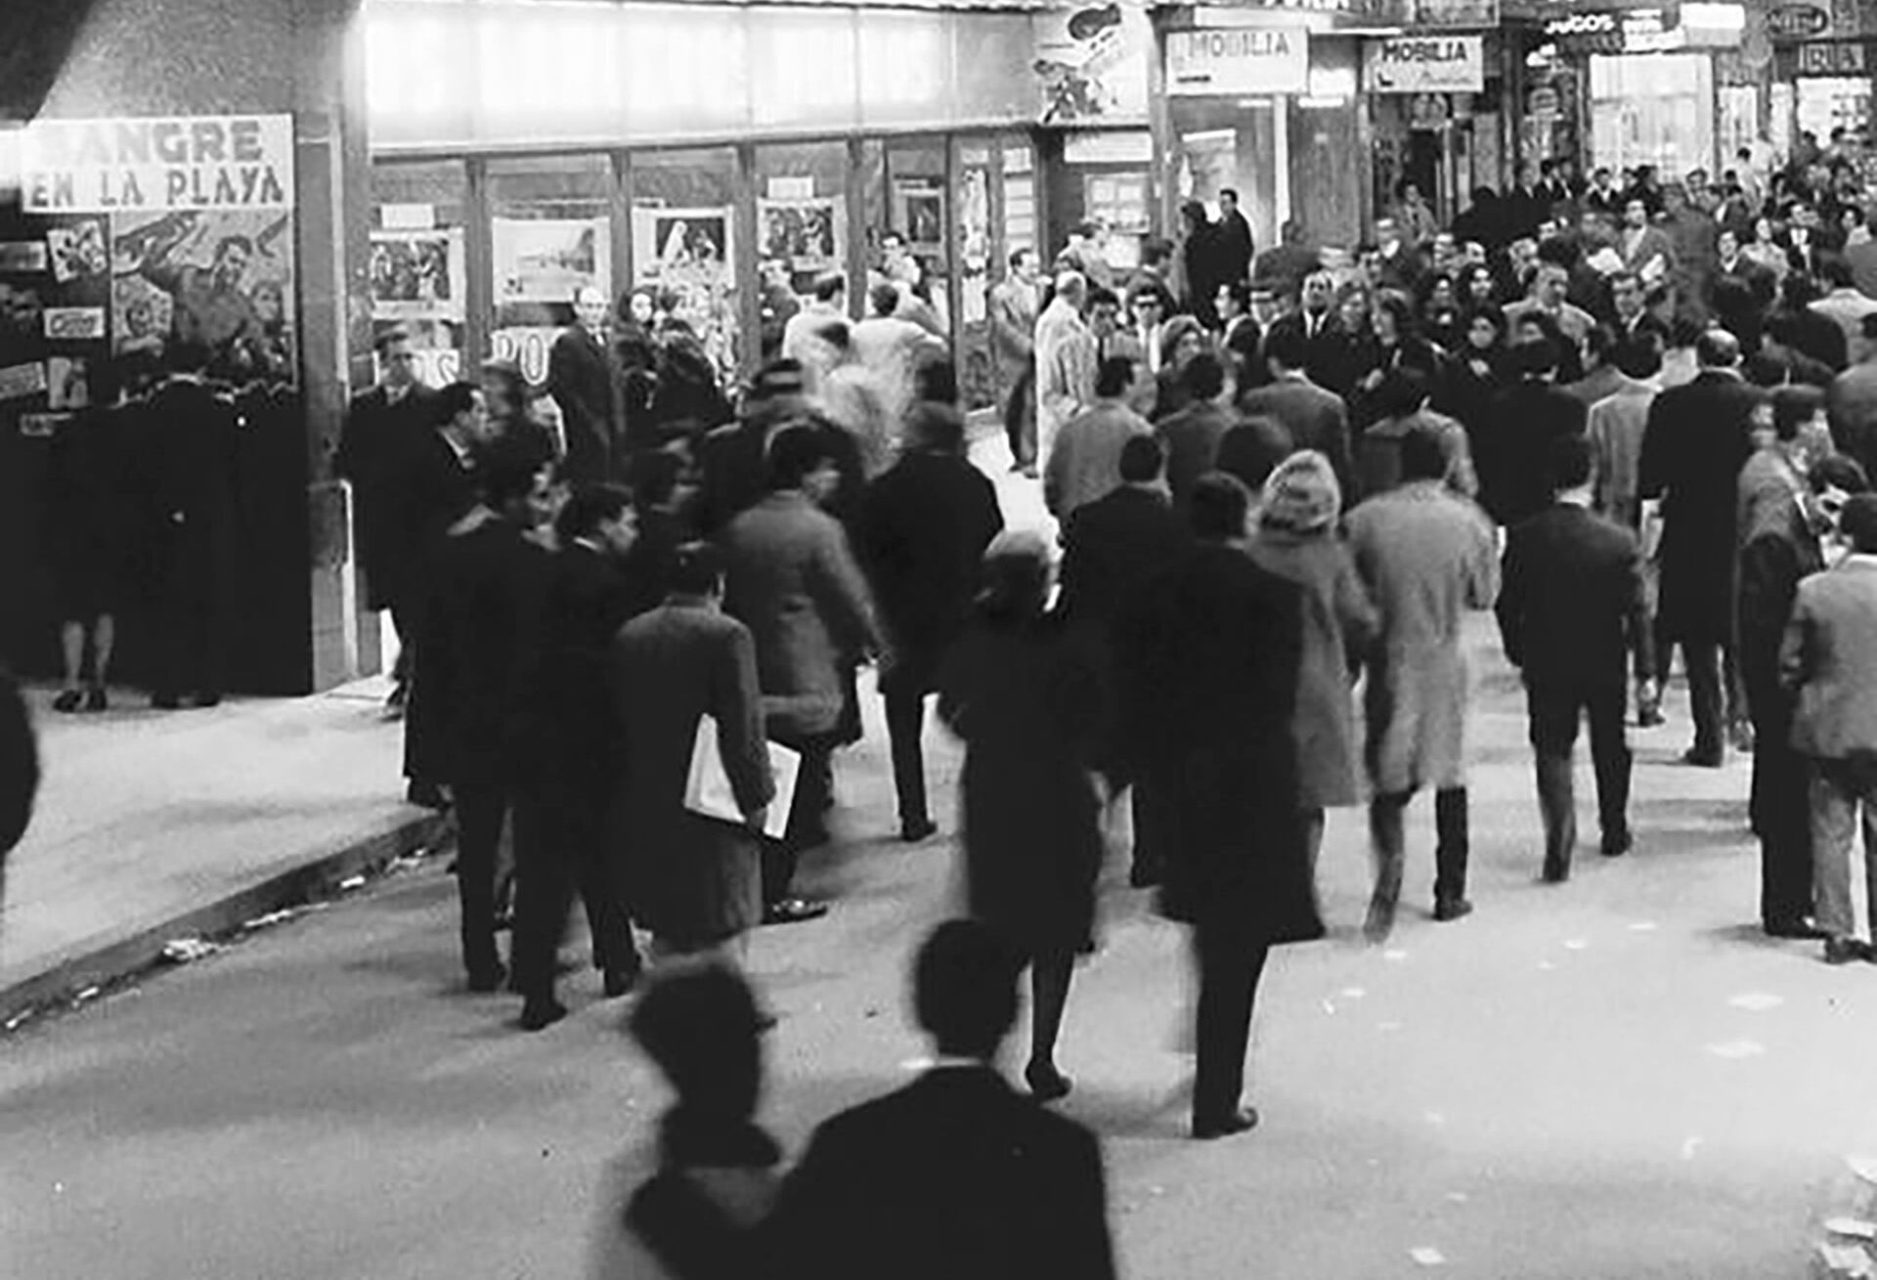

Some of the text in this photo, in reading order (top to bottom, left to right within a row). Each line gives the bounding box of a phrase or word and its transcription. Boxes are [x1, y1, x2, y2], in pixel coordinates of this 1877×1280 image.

[1380, 36, 1469, 64] MOBILIA
[30, 167, 284, 207] EN LA PLAYA
